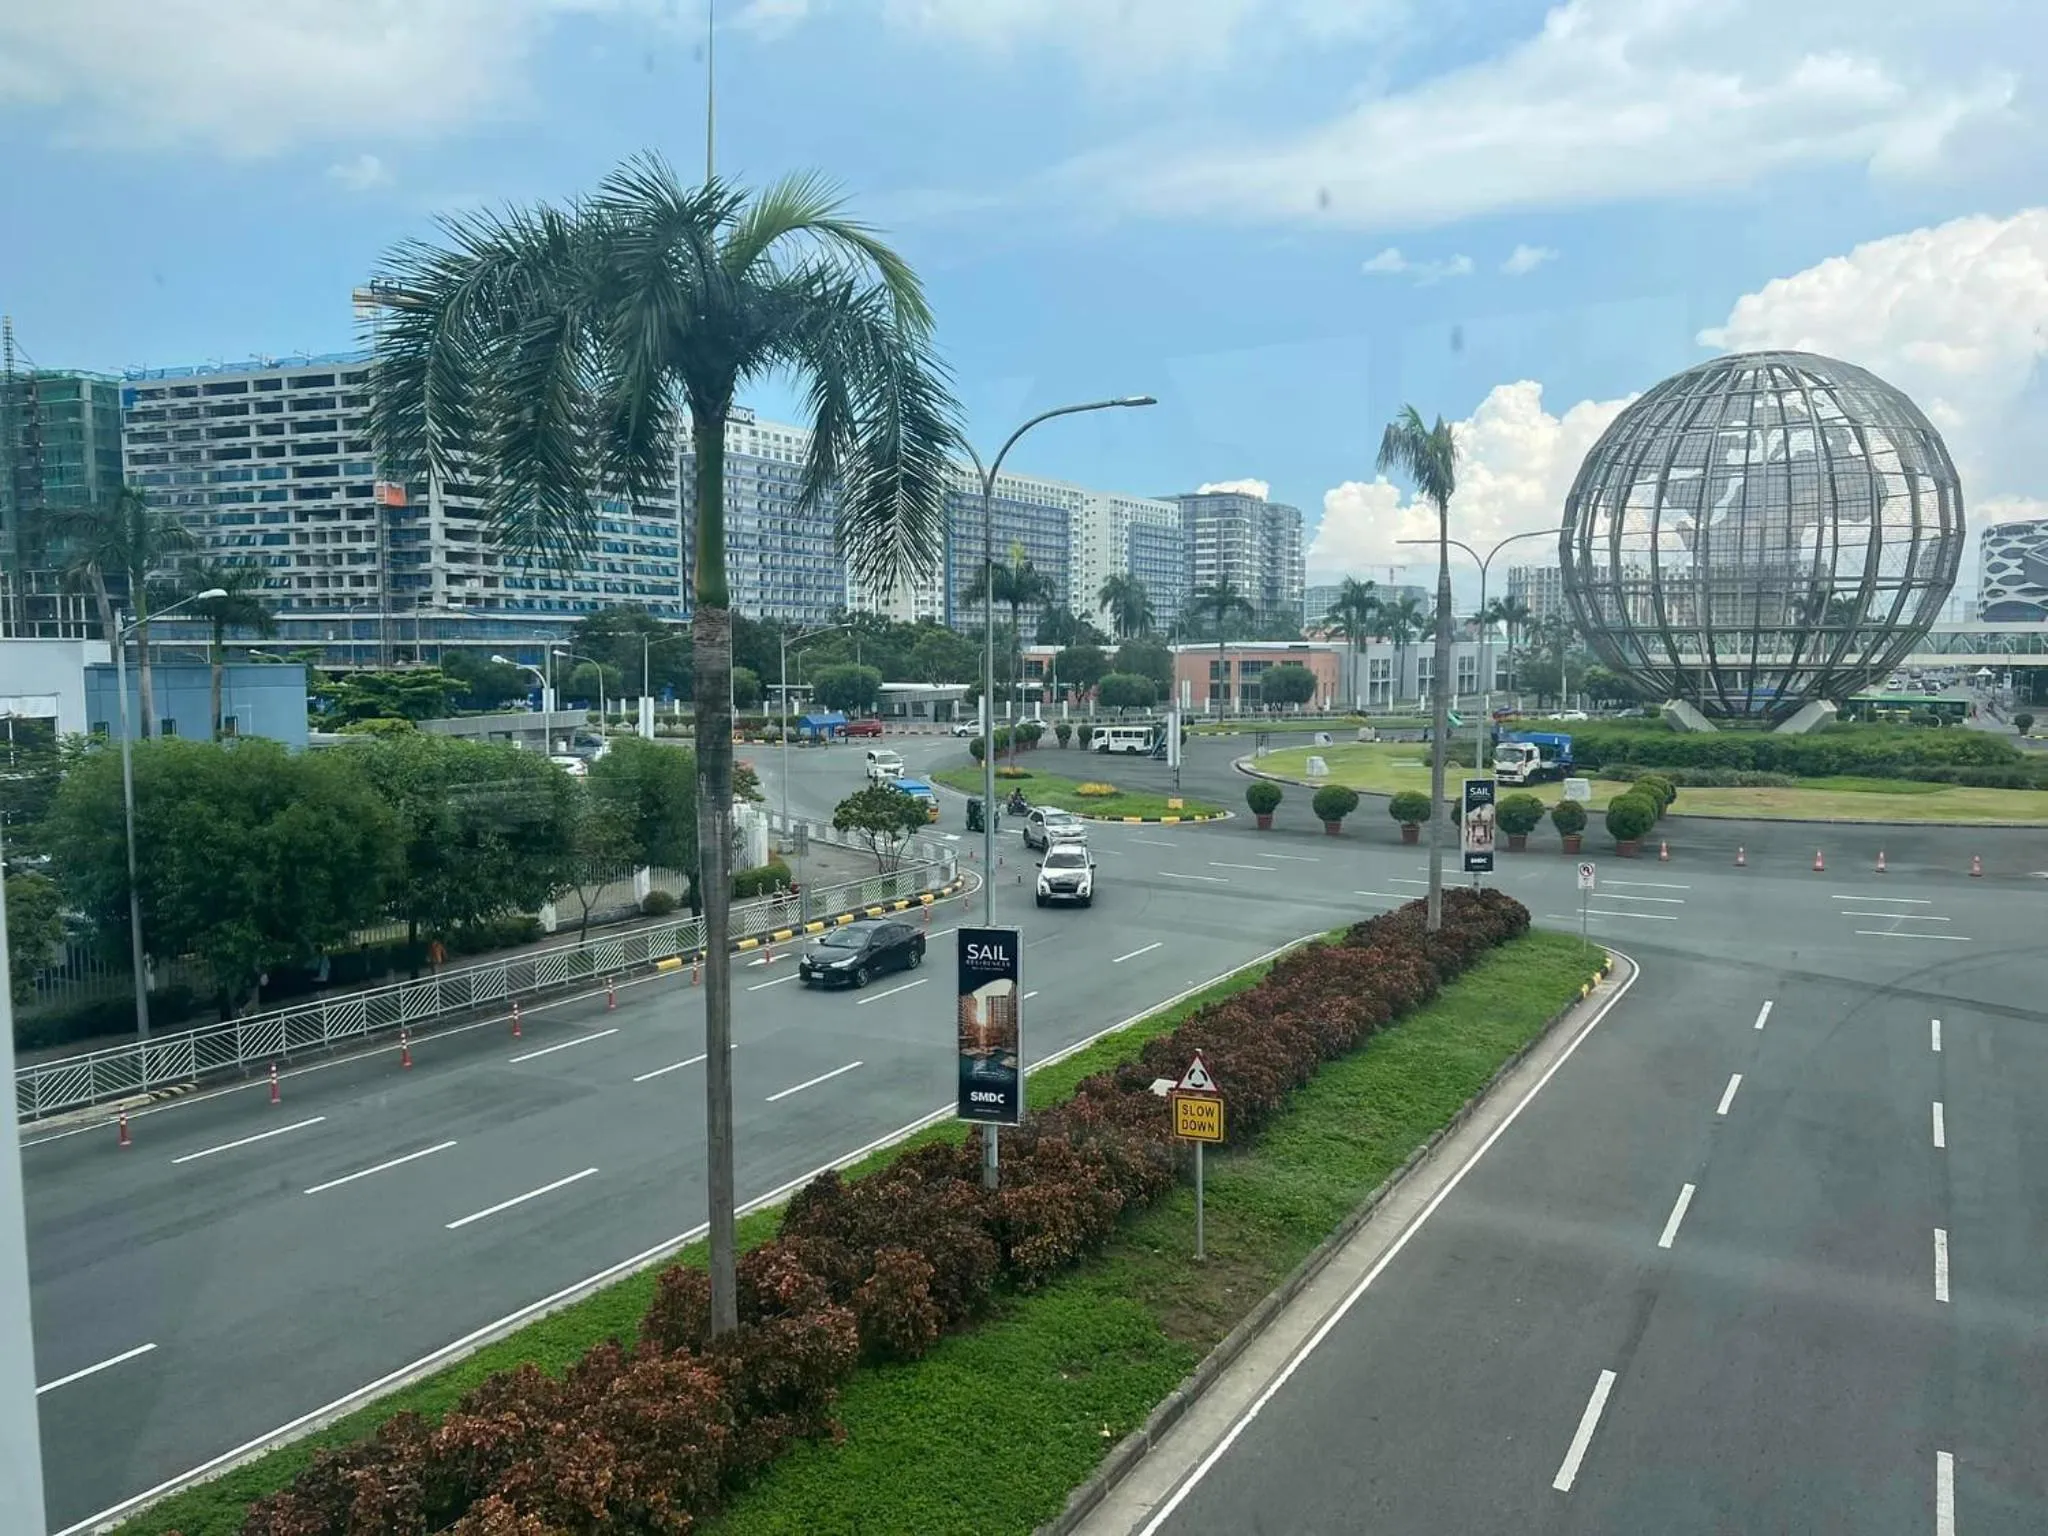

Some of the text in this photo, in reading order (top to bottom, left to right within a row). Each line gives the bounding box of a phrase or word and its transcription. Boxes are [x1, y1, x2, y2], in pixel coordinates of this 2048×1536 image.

[1470, 787, 1491, 795] SAIL
[968, 944, 1010, 961] SAIL
[970, 1091, 1005, 1104] SMDC
[1182, 1104, 1215, 1118] SLOW
[1182, 1120, 1215, 1132] DOWN
